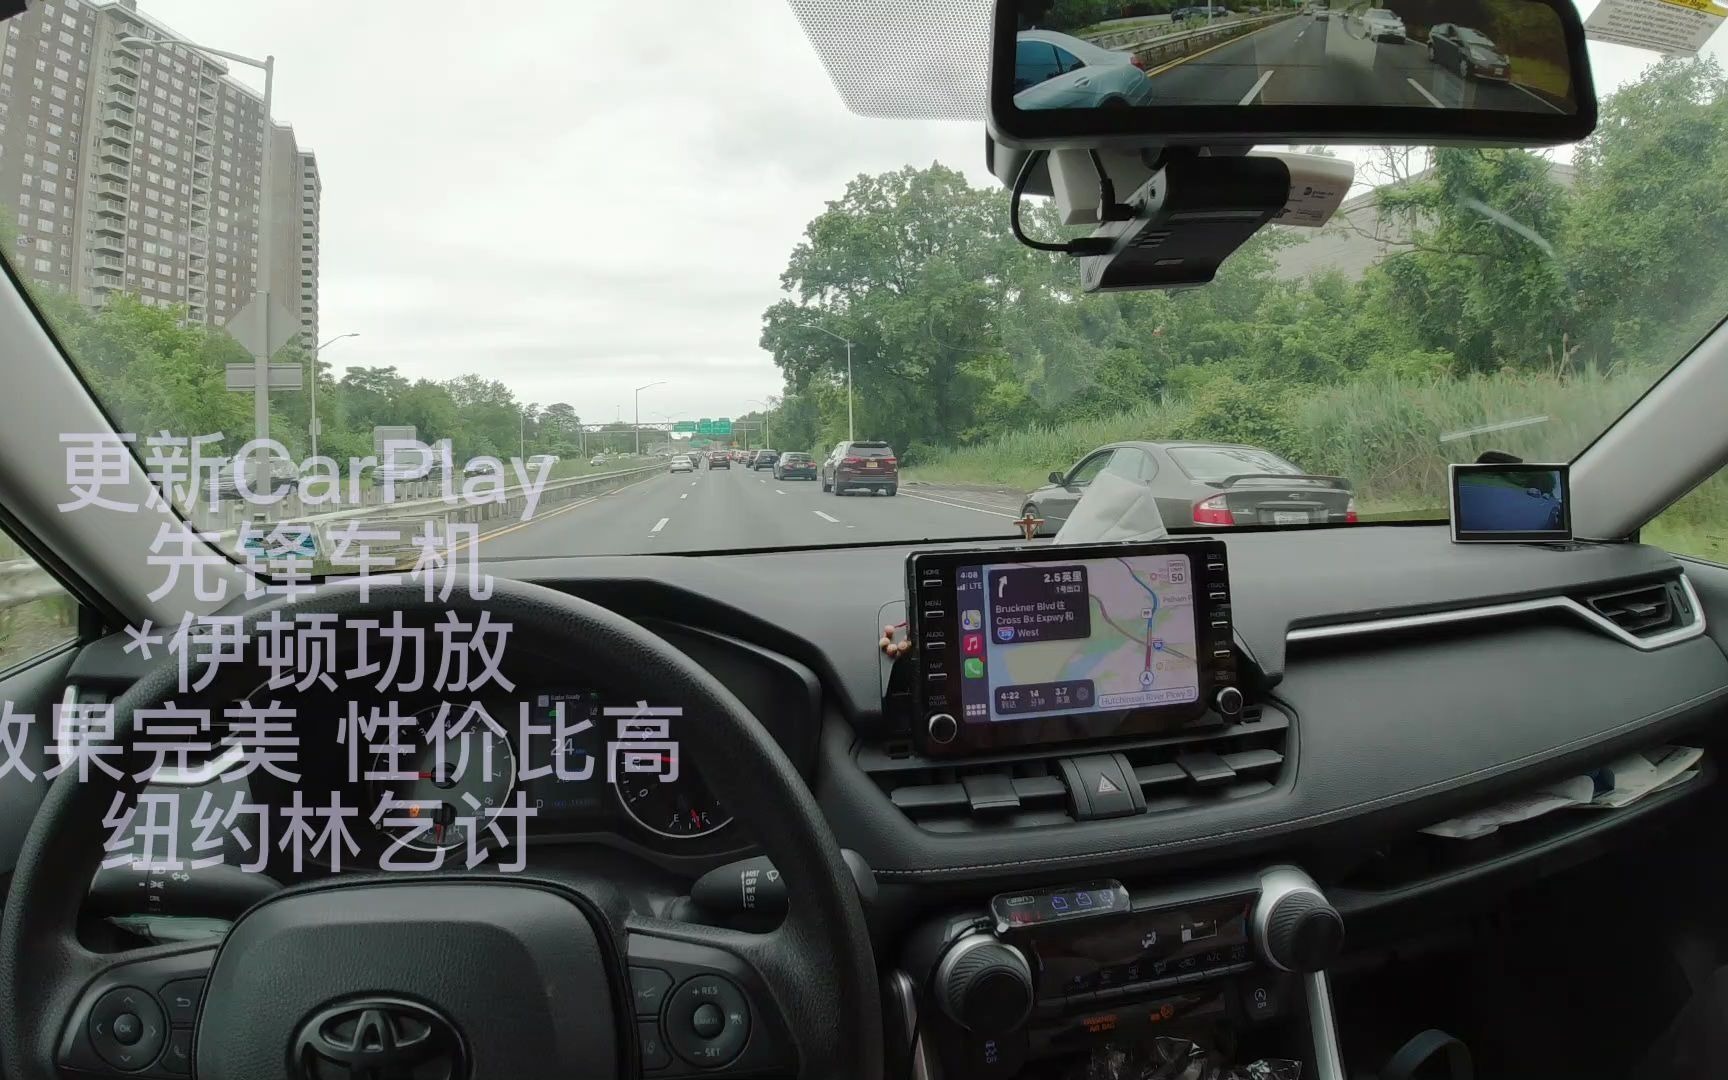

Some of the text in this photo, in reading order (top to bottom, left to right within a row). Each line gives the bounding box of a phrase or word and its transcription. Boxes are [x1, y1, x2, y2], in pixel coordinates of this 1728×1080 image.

[1171, 573, 1184, 582] 50
[969, 582, 982, 590] LTE
[995, 604, 1035, 614] Bruckner
[996, 616, 1021, 625] Cross
[1023, 615, 1034, 624] Bx
[1017, 628, 1040, 637] West
[1000, 691, 1020, 700] 4:22
[1030, 689, 1040, 697] 14
[1055, 687, 1068, 696] 3.7
[551, 738, 575, 757] 24
[745, 878, 757, 886] OFF
[701, 986, 718, 995] RES
[119, 1024, 132, 1033] OK
[704, 1047, 721, 1057] SET
